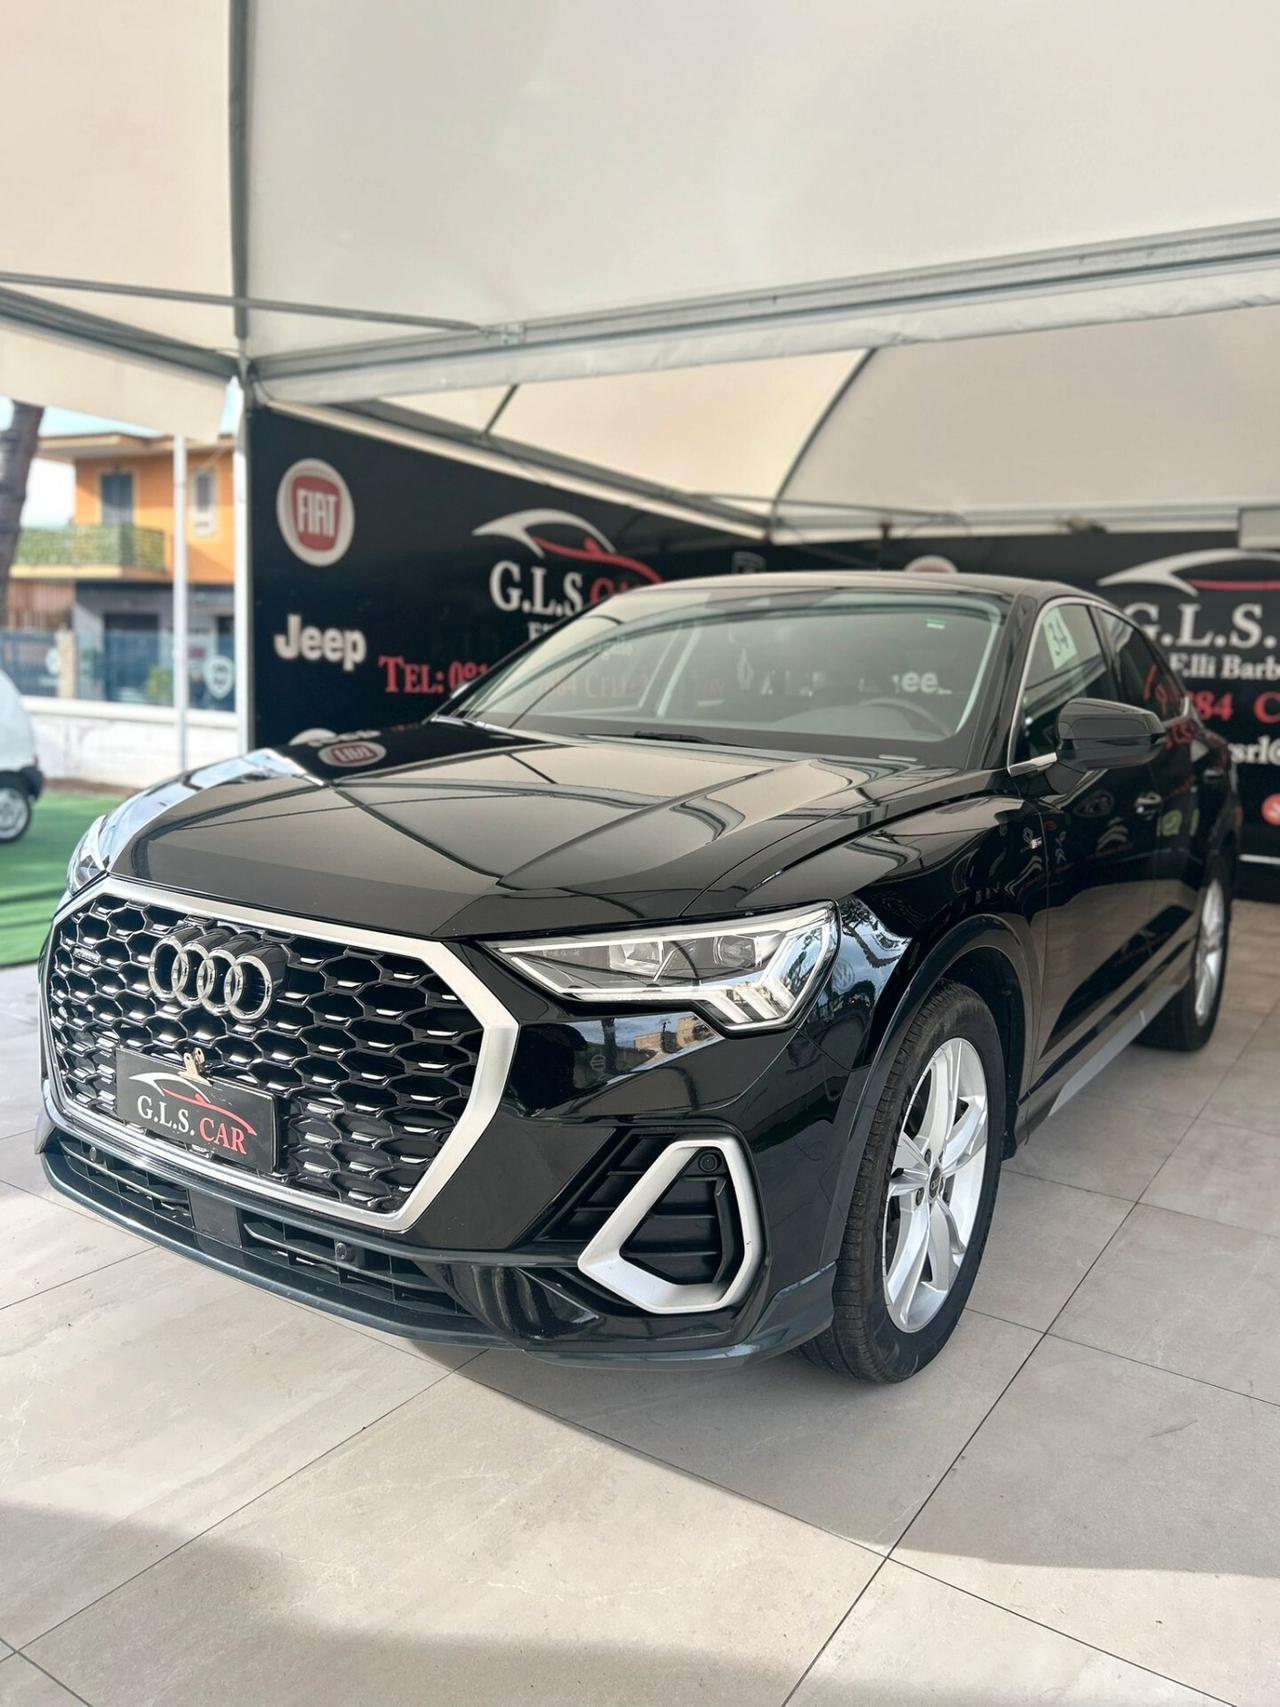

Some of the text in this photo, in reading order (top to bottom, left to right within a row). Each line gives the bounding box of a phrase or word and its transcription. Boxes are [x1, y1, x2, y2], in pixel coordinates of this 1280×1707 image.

[298, 488, 337, 537] FIAT
[274, 614, 366, 671] Jeep
[137, 1095, 247, 1155] G.L.S. CAR
